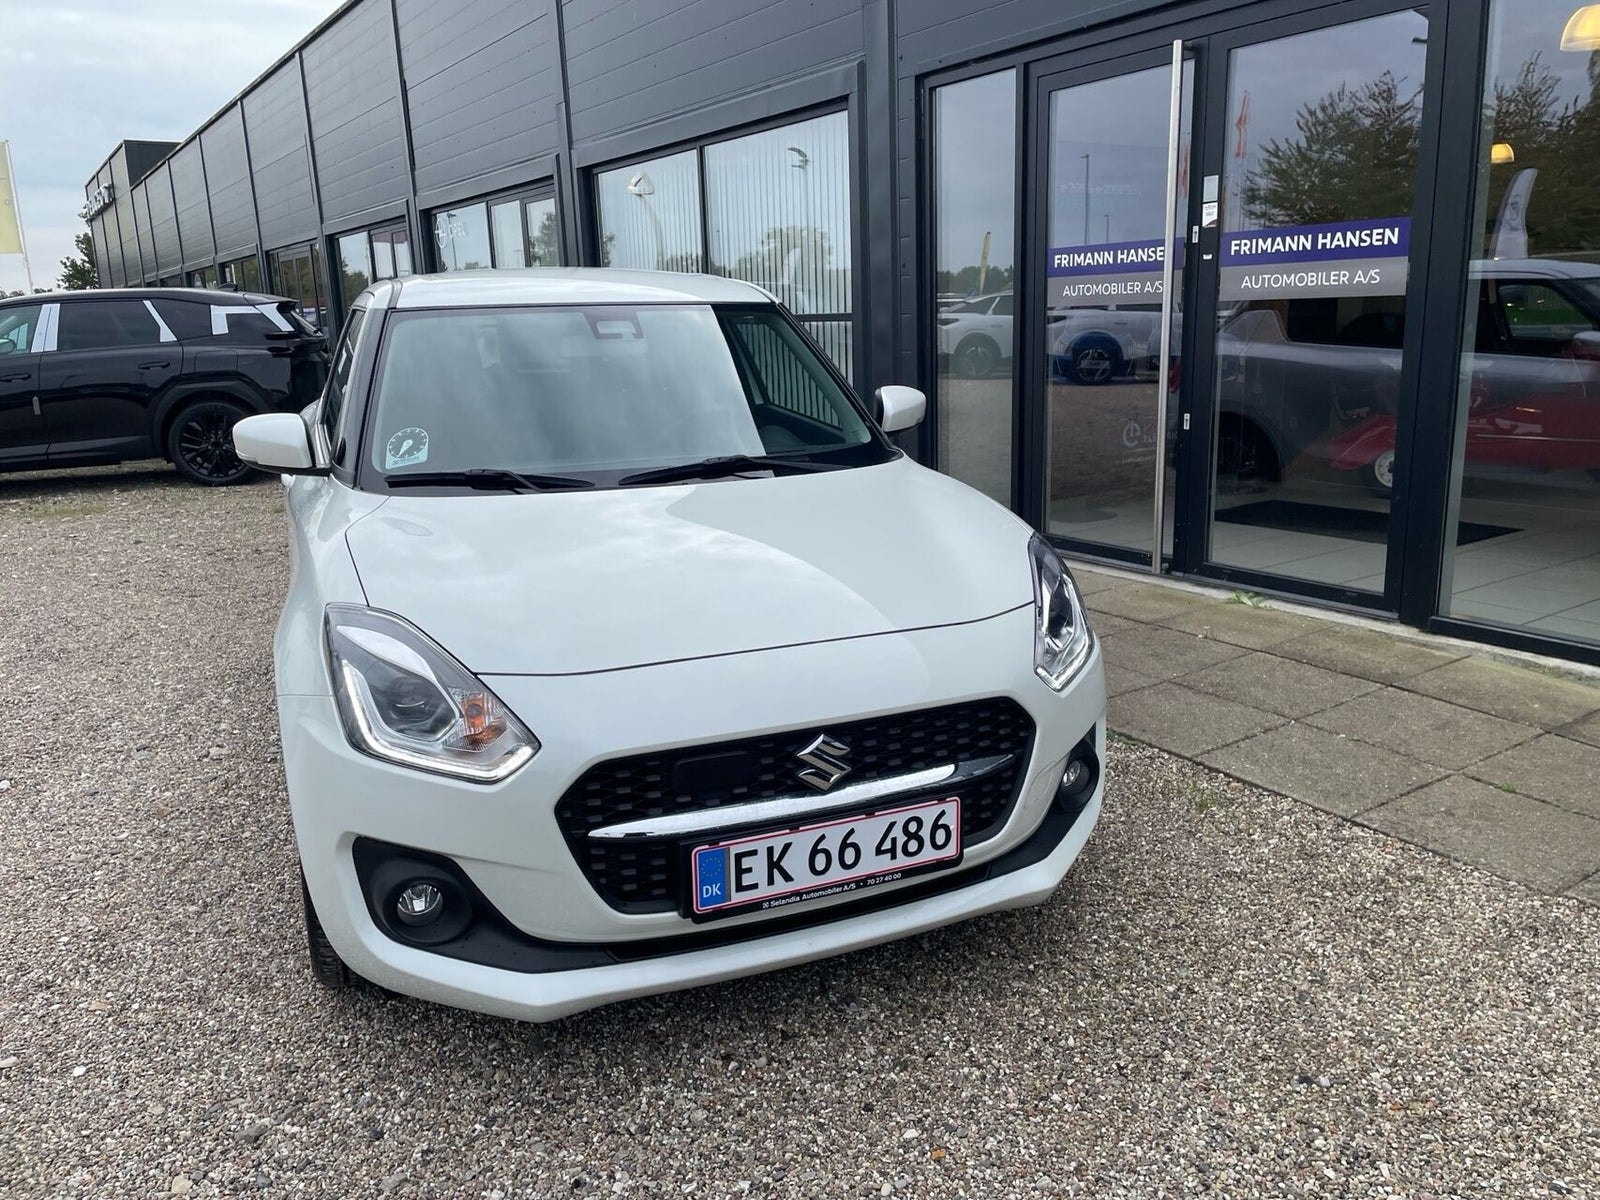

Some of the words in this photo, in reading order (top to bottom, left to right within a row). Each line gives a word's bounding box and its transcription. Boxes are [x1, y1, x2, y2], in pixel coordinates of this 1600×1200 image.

[1230, 234, 1312, 256] FRIMANN
[1317, 228, 1399, 250] HANSEN
[1054, 250, 1113, 268] FRIMANN
[1117, 246, 1164, 263] HANSE
[1063, 281, 1141, 297] AUTOMOBILER
[1144, 280, 1163, 293] A/S
[1241, 271, 1349, 289] AUTOMOBILER
[1353, 269, 1380, 284] A/S
[734, 842, 794, 893] EK
[808, 827, 862, 876] 66
[875, 809, 953, 860] 486
[702, 883, 722, 898] DK
[770, 896, 801, 908] Selandia
[801, 887, 843, 901] Automobiler
[843, 882, 856, 892] A/S
